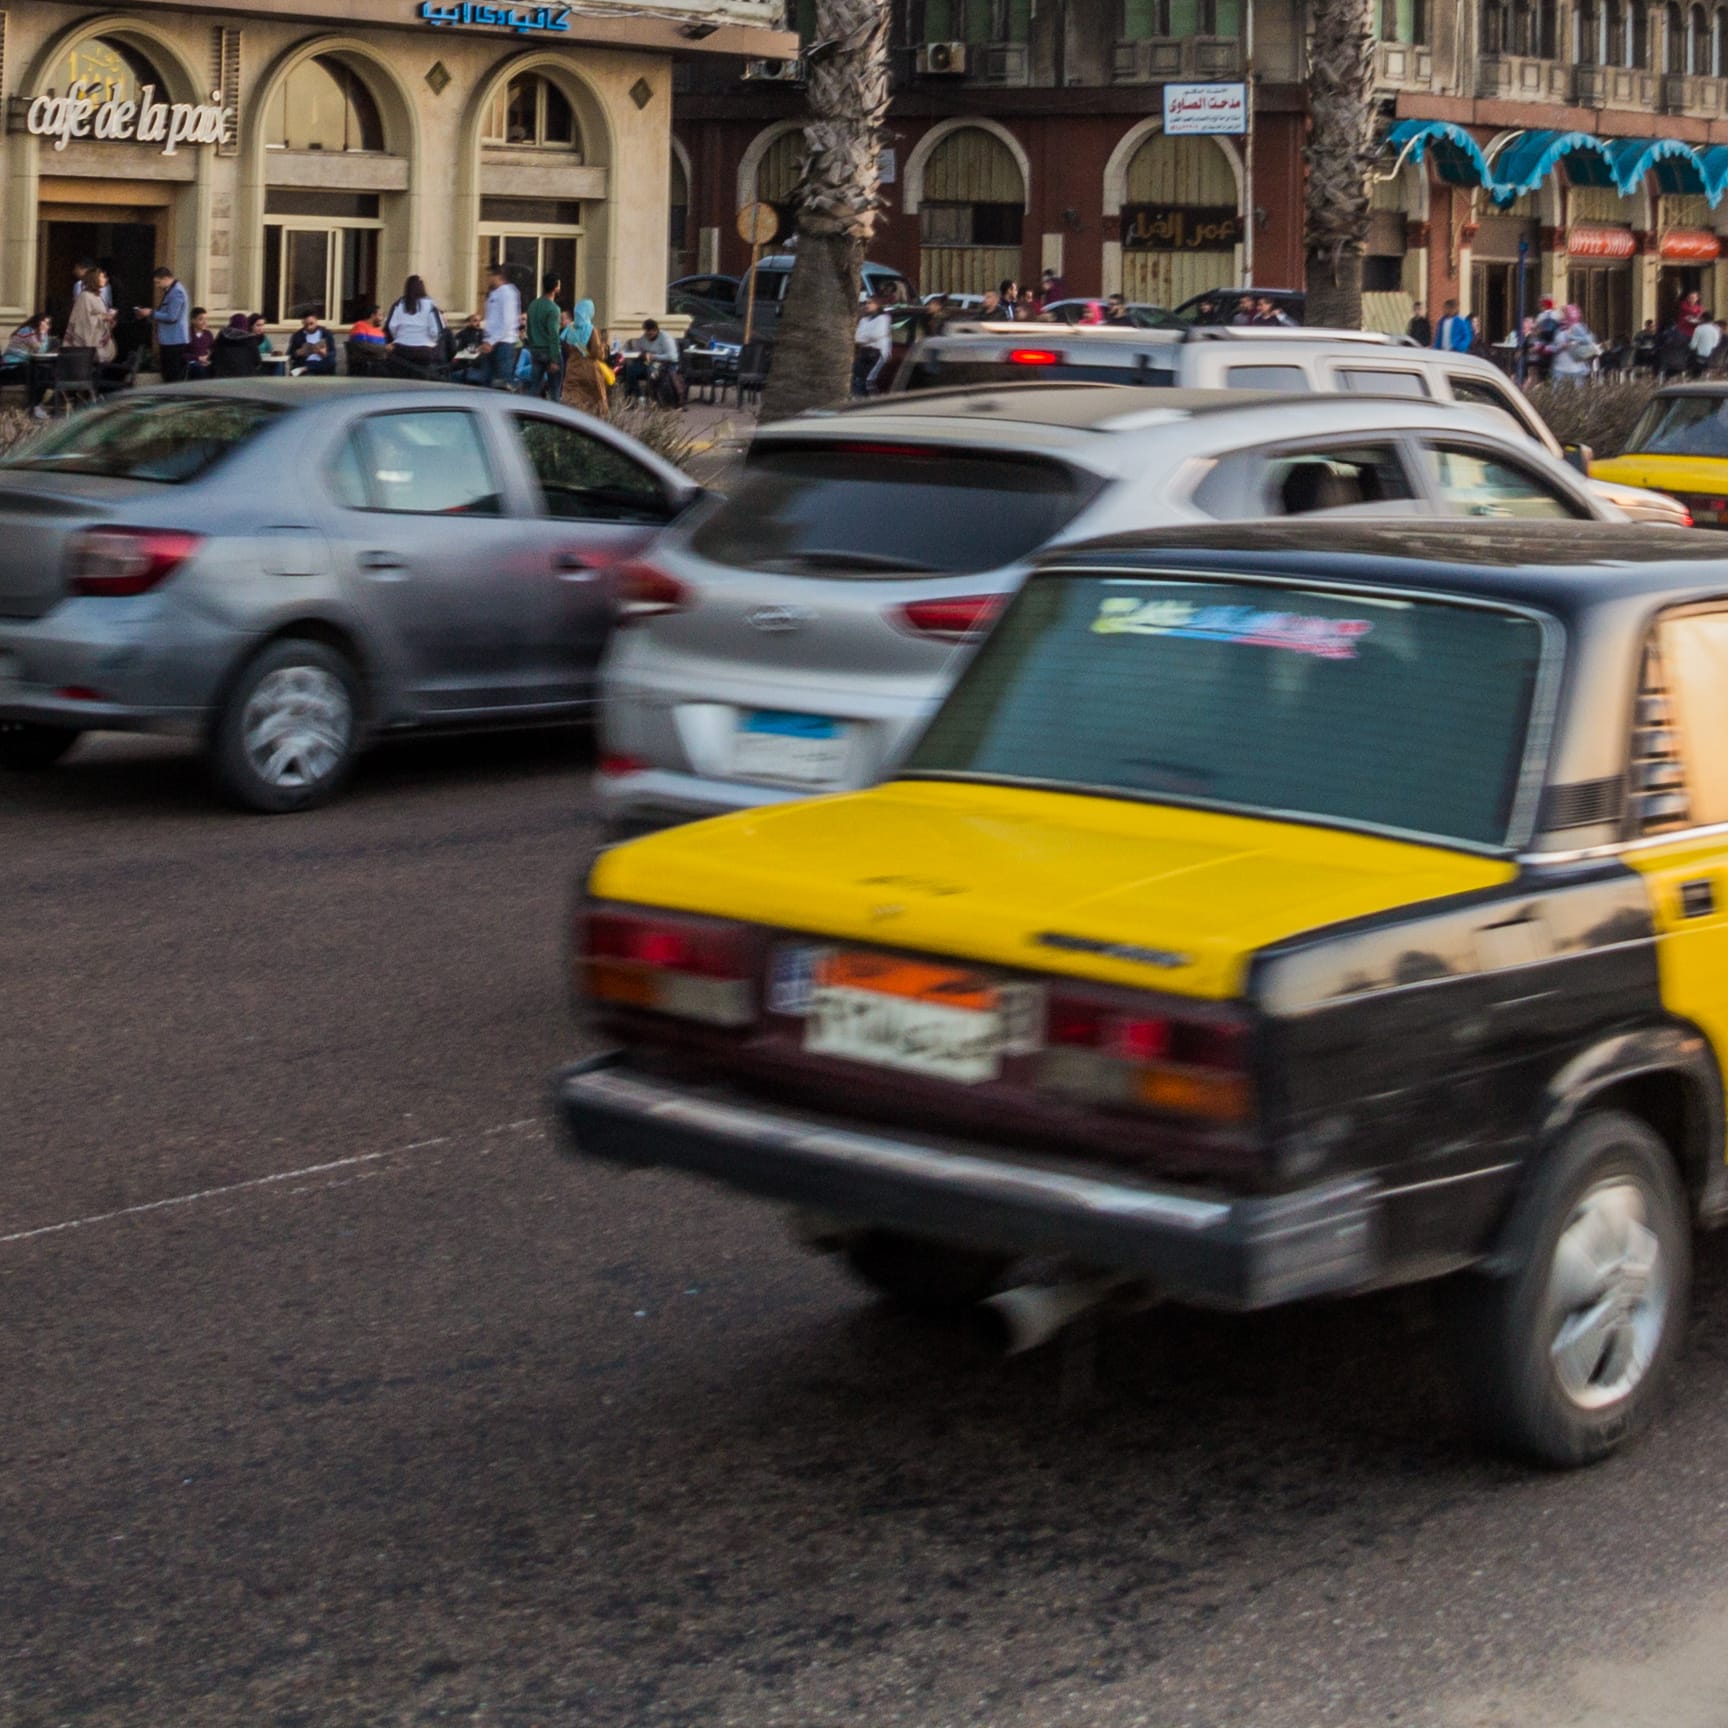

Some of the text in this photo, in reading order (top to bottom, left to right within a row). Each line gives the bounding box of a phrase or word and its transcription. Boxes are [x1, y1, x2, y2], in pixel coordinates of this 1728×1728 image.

[28, 80, 234, 156] café de la paix
[1185, 219, 1234, 247] عمر
